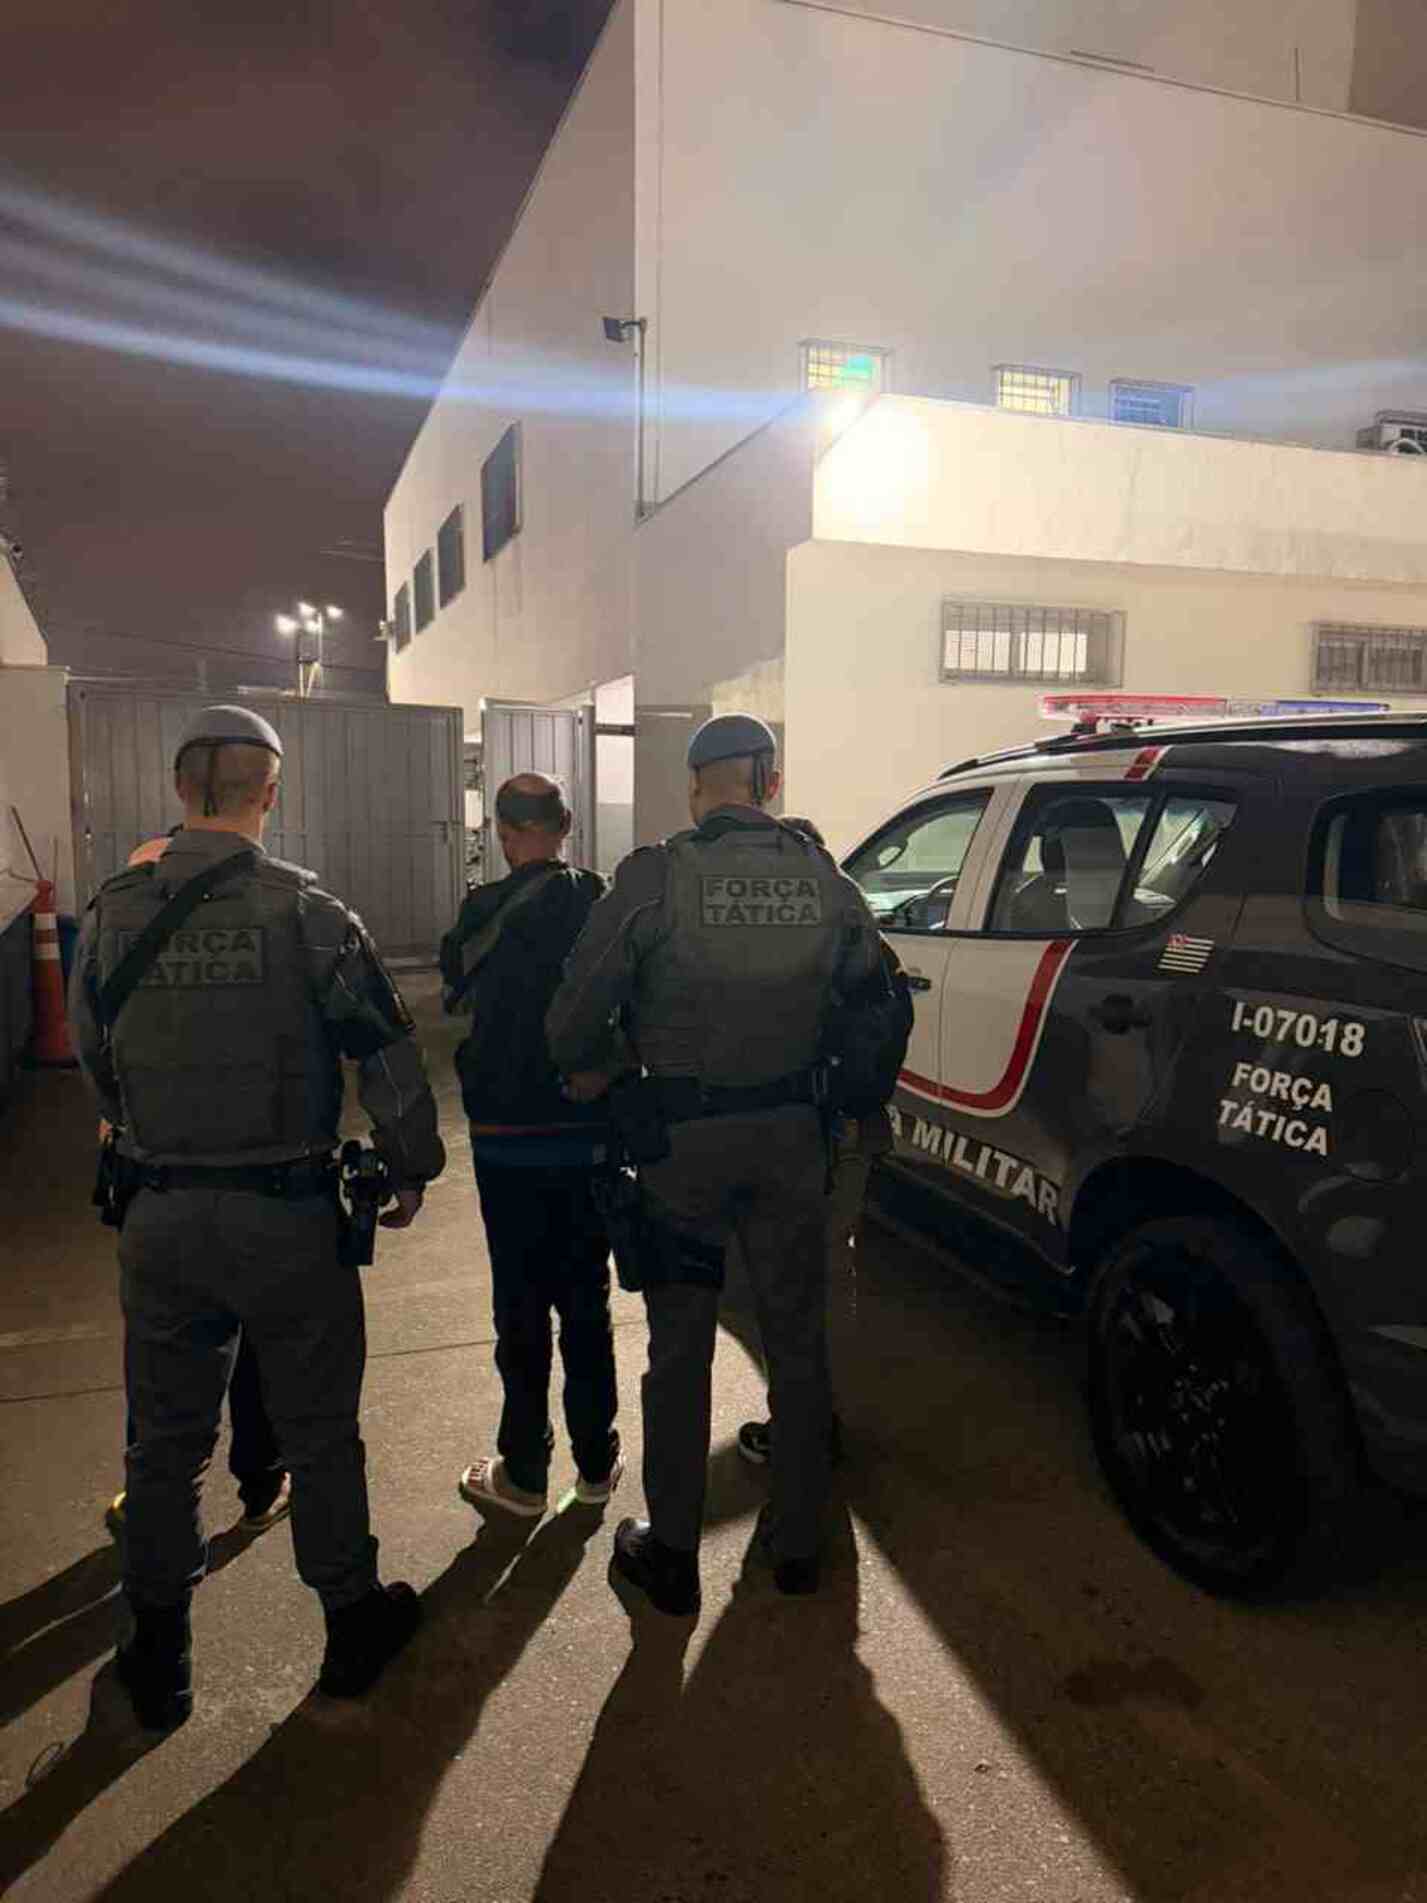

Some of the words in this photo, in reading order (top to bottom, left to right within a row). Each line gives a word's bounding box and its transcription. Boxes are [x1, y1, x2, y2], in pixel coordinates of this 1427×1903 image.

[706, 877, 815, 901] FORÇA
[1231, 1062, 1333, 1112] FORÇA
[1217, 1099, 1328, 1156] TÁTICA
[911, 1117, 1058, 1226] MILITAR
